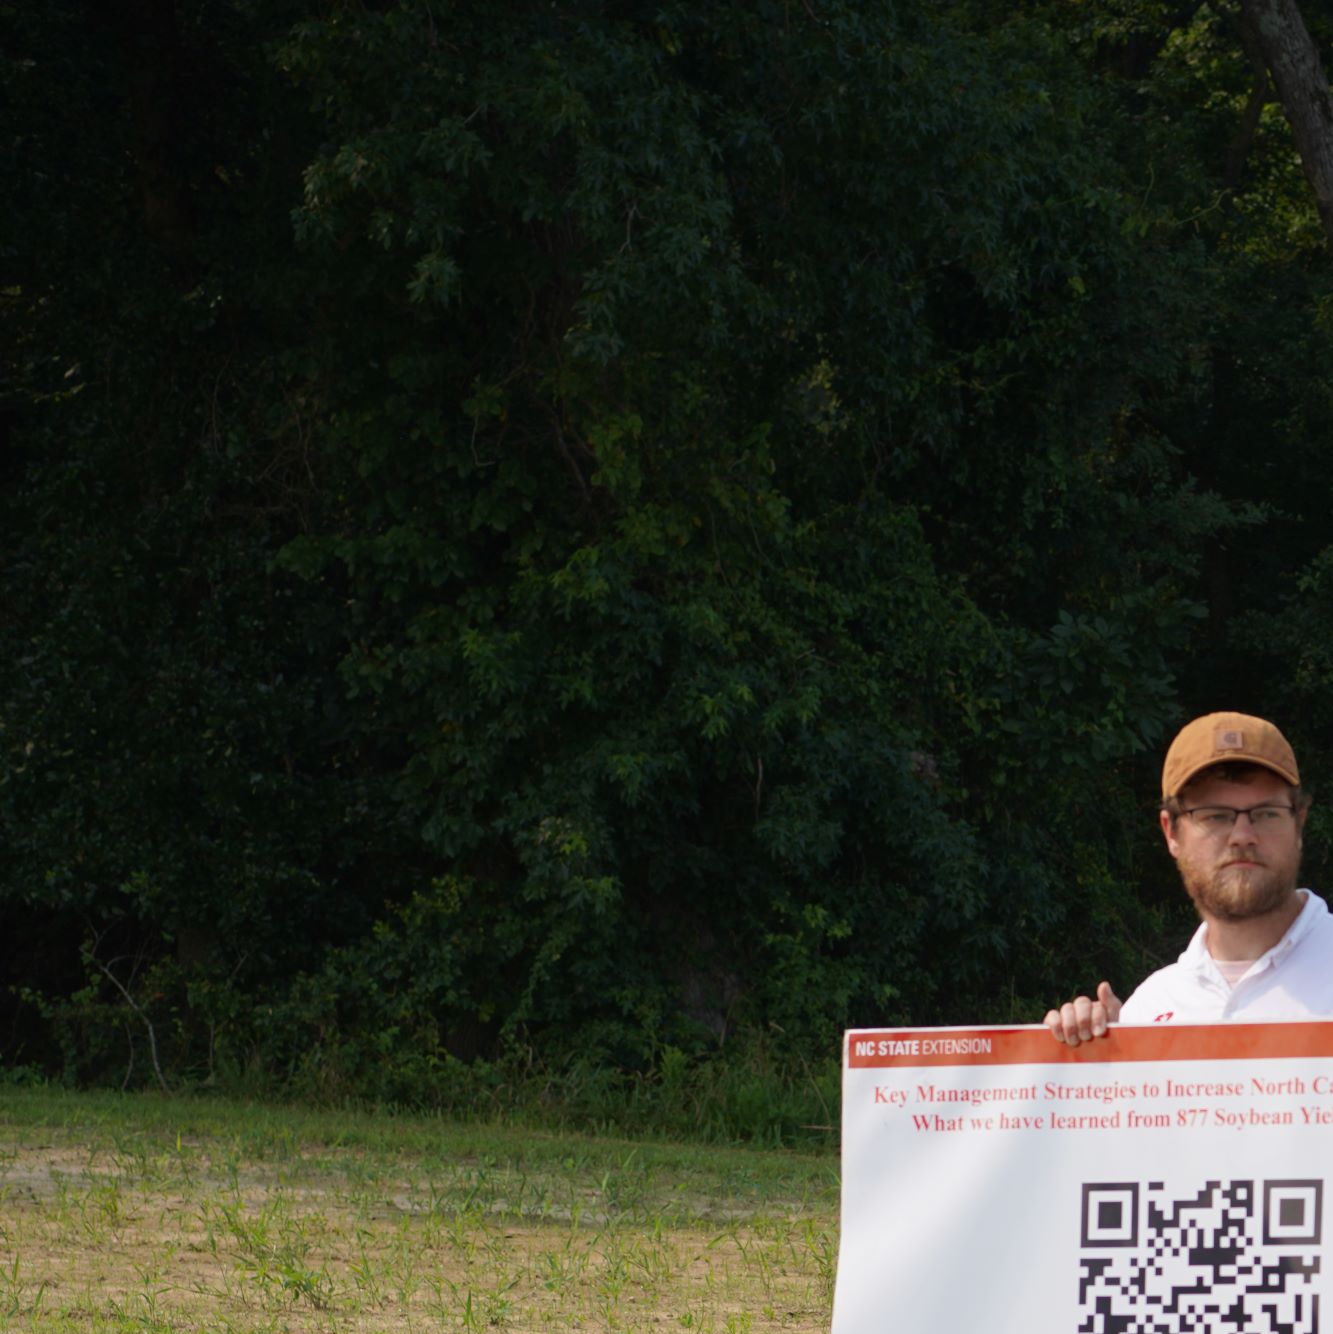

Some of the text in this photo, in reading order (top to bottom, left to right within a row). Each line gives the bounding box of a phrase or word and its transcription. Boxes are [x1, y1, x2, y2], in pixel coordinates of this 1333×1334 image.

[855, 1038, 992, 1057] NC STATE EXTENSION
[874, 1086, 908, 1107] Key
[917, 1085, 1037, 1106] Management
[1044, 1081, 1136, 1104] Strategies
[1143, 1082, 1159, 1097] to
[1167, 1079, 1244, 1097] Increase
[1251, 1077, 1305, 1096] North
[912, 1114, 964, 1132] What
[971, 1118, 993, 1130] we
[1000, 1112, 1044, 1130] have
[1051, 1111, 1121, 1129] learned
[1127, 1110, 1170, 1128] from
[1177, 1108, 1208, 1127] 877
[1214, 1107, 1293, 1131] Soybean
